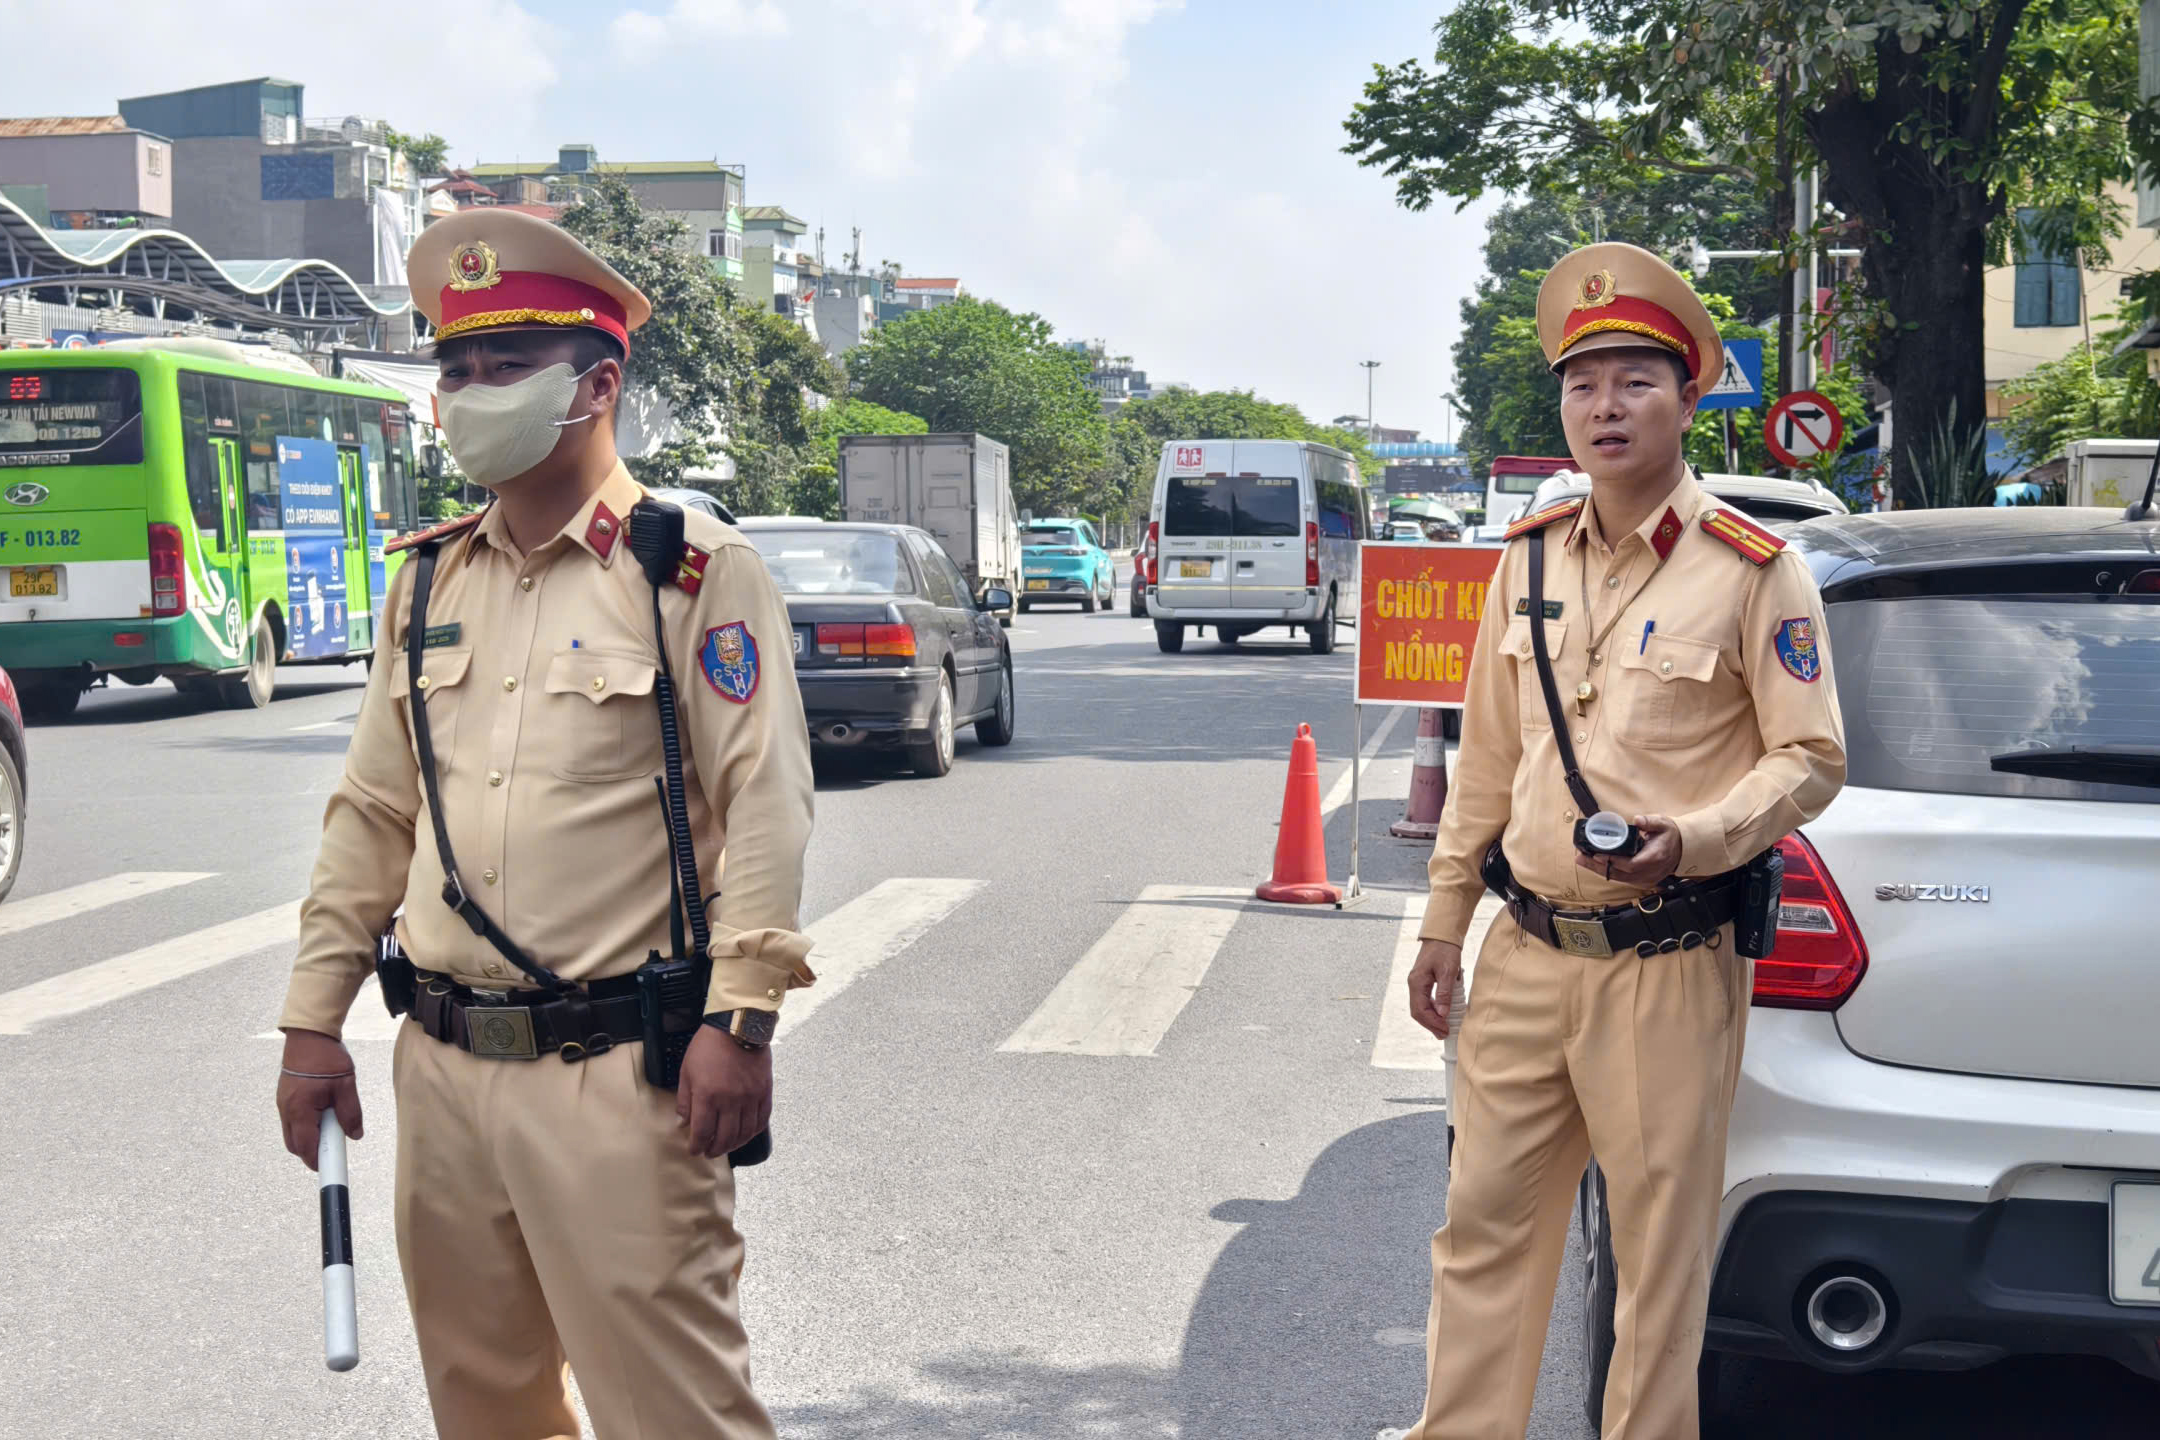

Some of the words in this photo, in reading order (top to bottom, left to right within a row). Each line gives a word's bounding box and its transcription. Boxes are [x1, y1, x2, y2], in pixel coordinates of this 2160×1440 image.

[51, 405, 97, 419] NEWWAY
[26, 529, 80, 547] 013.82
[16, 584, 52, 595] 013.82
[1377, 566, 1449, 620] CHỐT
[1457, 574, 1494, 621] KI
[1385, 628, 1464, 683] NỒNG
[1875, 883, 1990, 902] SUZUKI
